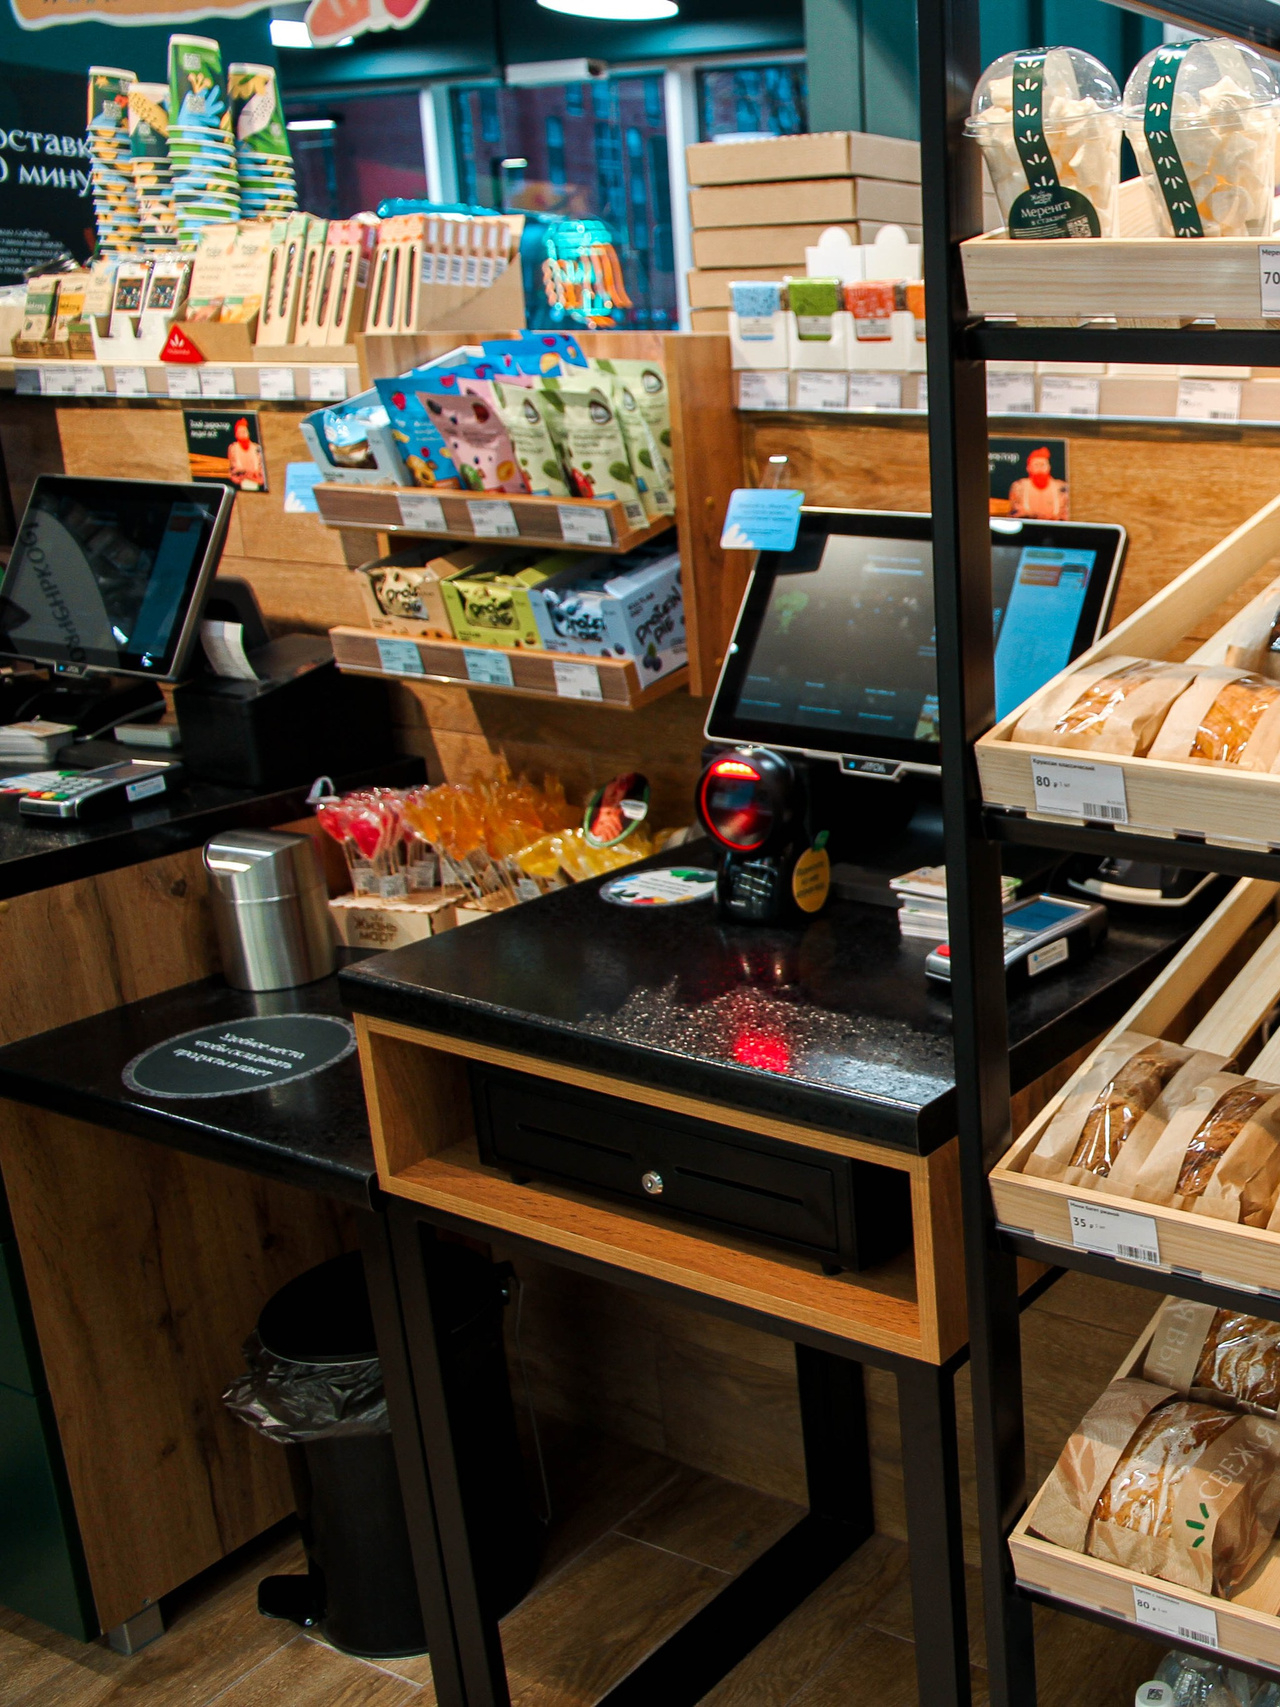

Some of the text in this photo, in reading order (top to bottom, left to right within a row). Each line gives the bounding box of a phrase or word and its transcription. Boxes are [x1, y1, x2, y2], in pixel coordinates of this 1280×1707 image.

[18, 164, 93, 197] мину
[1021, 200, 1071, 219] Меренга
[1263, 271, 1280, 285] 70
[1036, 776, 1050, 787] 80
[1073, 1216, 1086, 1228] 35
[1199, 1423, 1279, 1500] СВЕЖАЯ
[1137, 1599, 1150, 1609] 80
